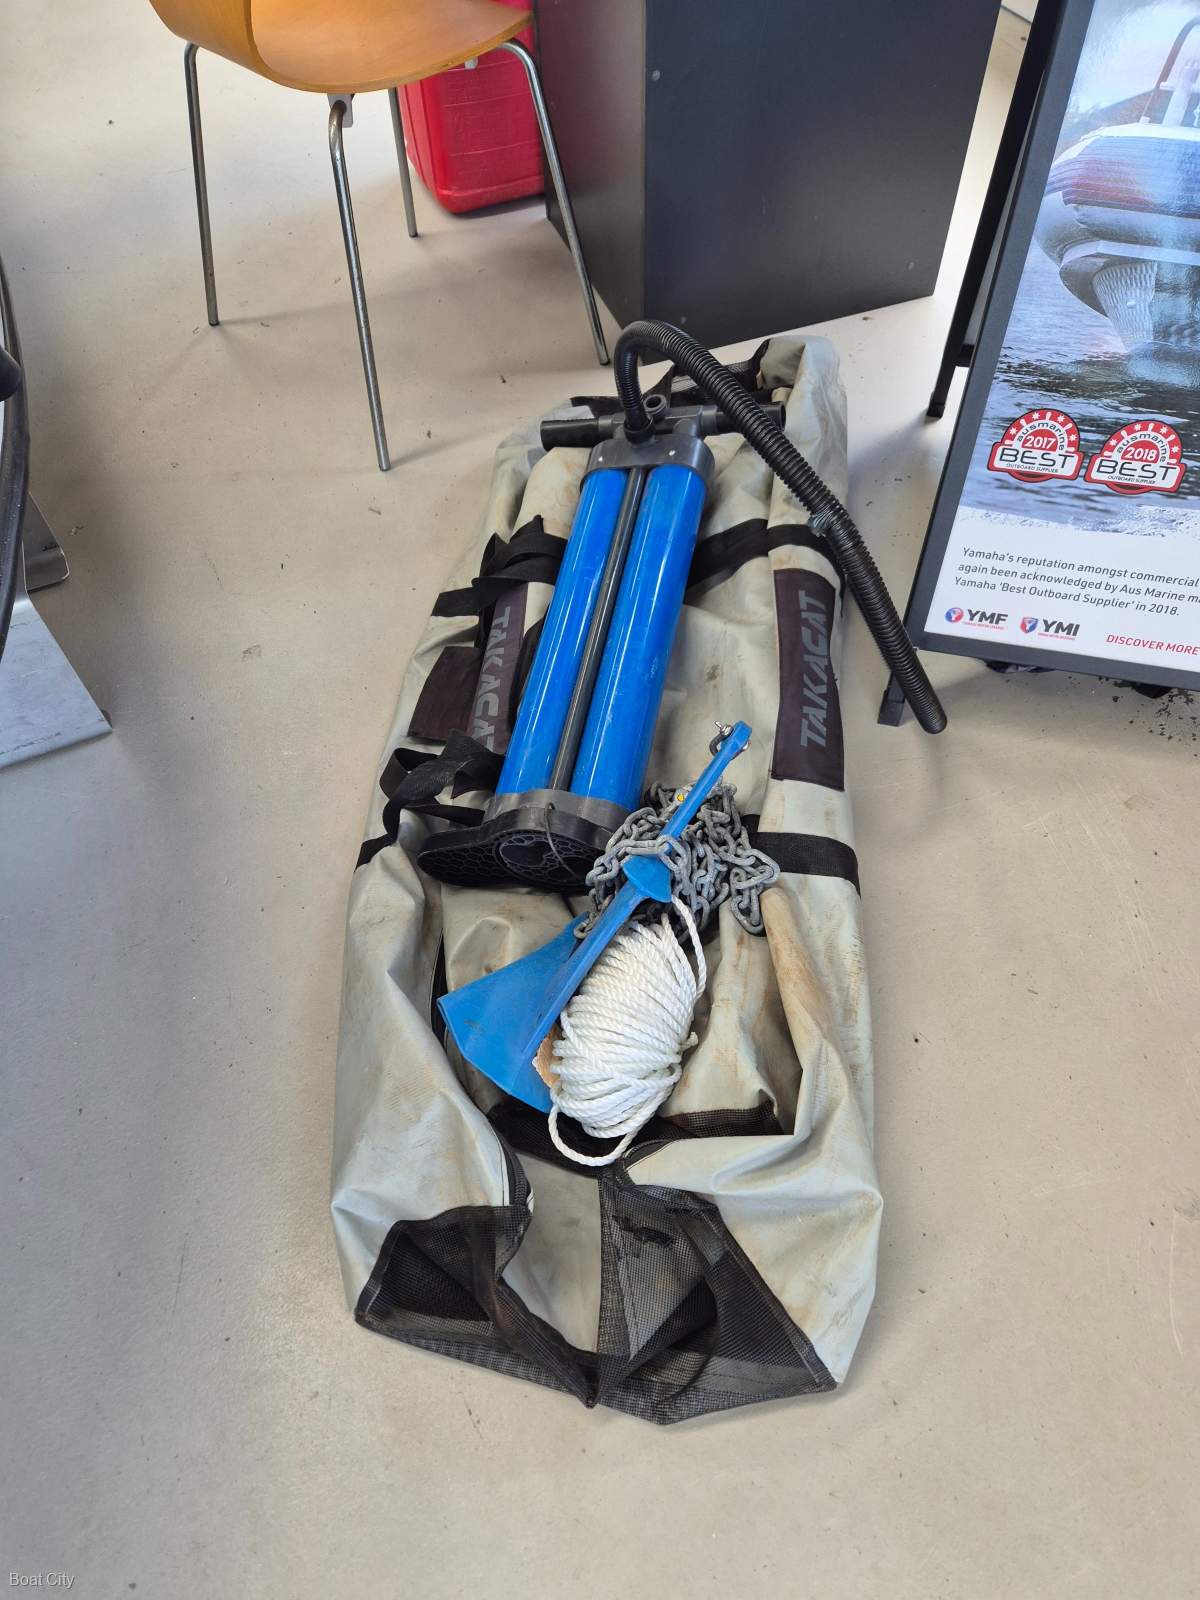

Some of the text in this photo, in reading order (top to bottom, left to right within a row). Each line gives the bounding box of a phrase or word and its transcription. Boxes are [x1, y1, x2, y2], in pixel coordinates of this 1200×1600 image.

[1017, 422, 1065, 451] ausmarine
[1024, 435, 1056, 449] 2017
[1116, 433, 1166, 462] ausmarine
[999, 447, 1075, 469] BEST
[1125, 447, 1157, 461] 2018
[1096, 459, 1177, 480] BEST
[963, 547, 1200, 588] Yamaha's reputation amongst commercial
[958, 563, 988, 577] again
[990, 565, 1018, 578] been
[1020, 570, 1102, 591] acknowledged
[1104, 580, 1119, 594] by
[1119, 583, 1142, 596] Aus
[1144, 587, 1185, 602] Marine
[955, 577, 1180, 616] Yamaha 'Best Outboard Supplier' in 2018.
[966, 609, 1009, 625] YMF
[1042, 619, 1080, 637] YMI
[1106, 634, 1200, 656] DISCOVER MORE
[798, 589, 828, 748] TAKACAT
